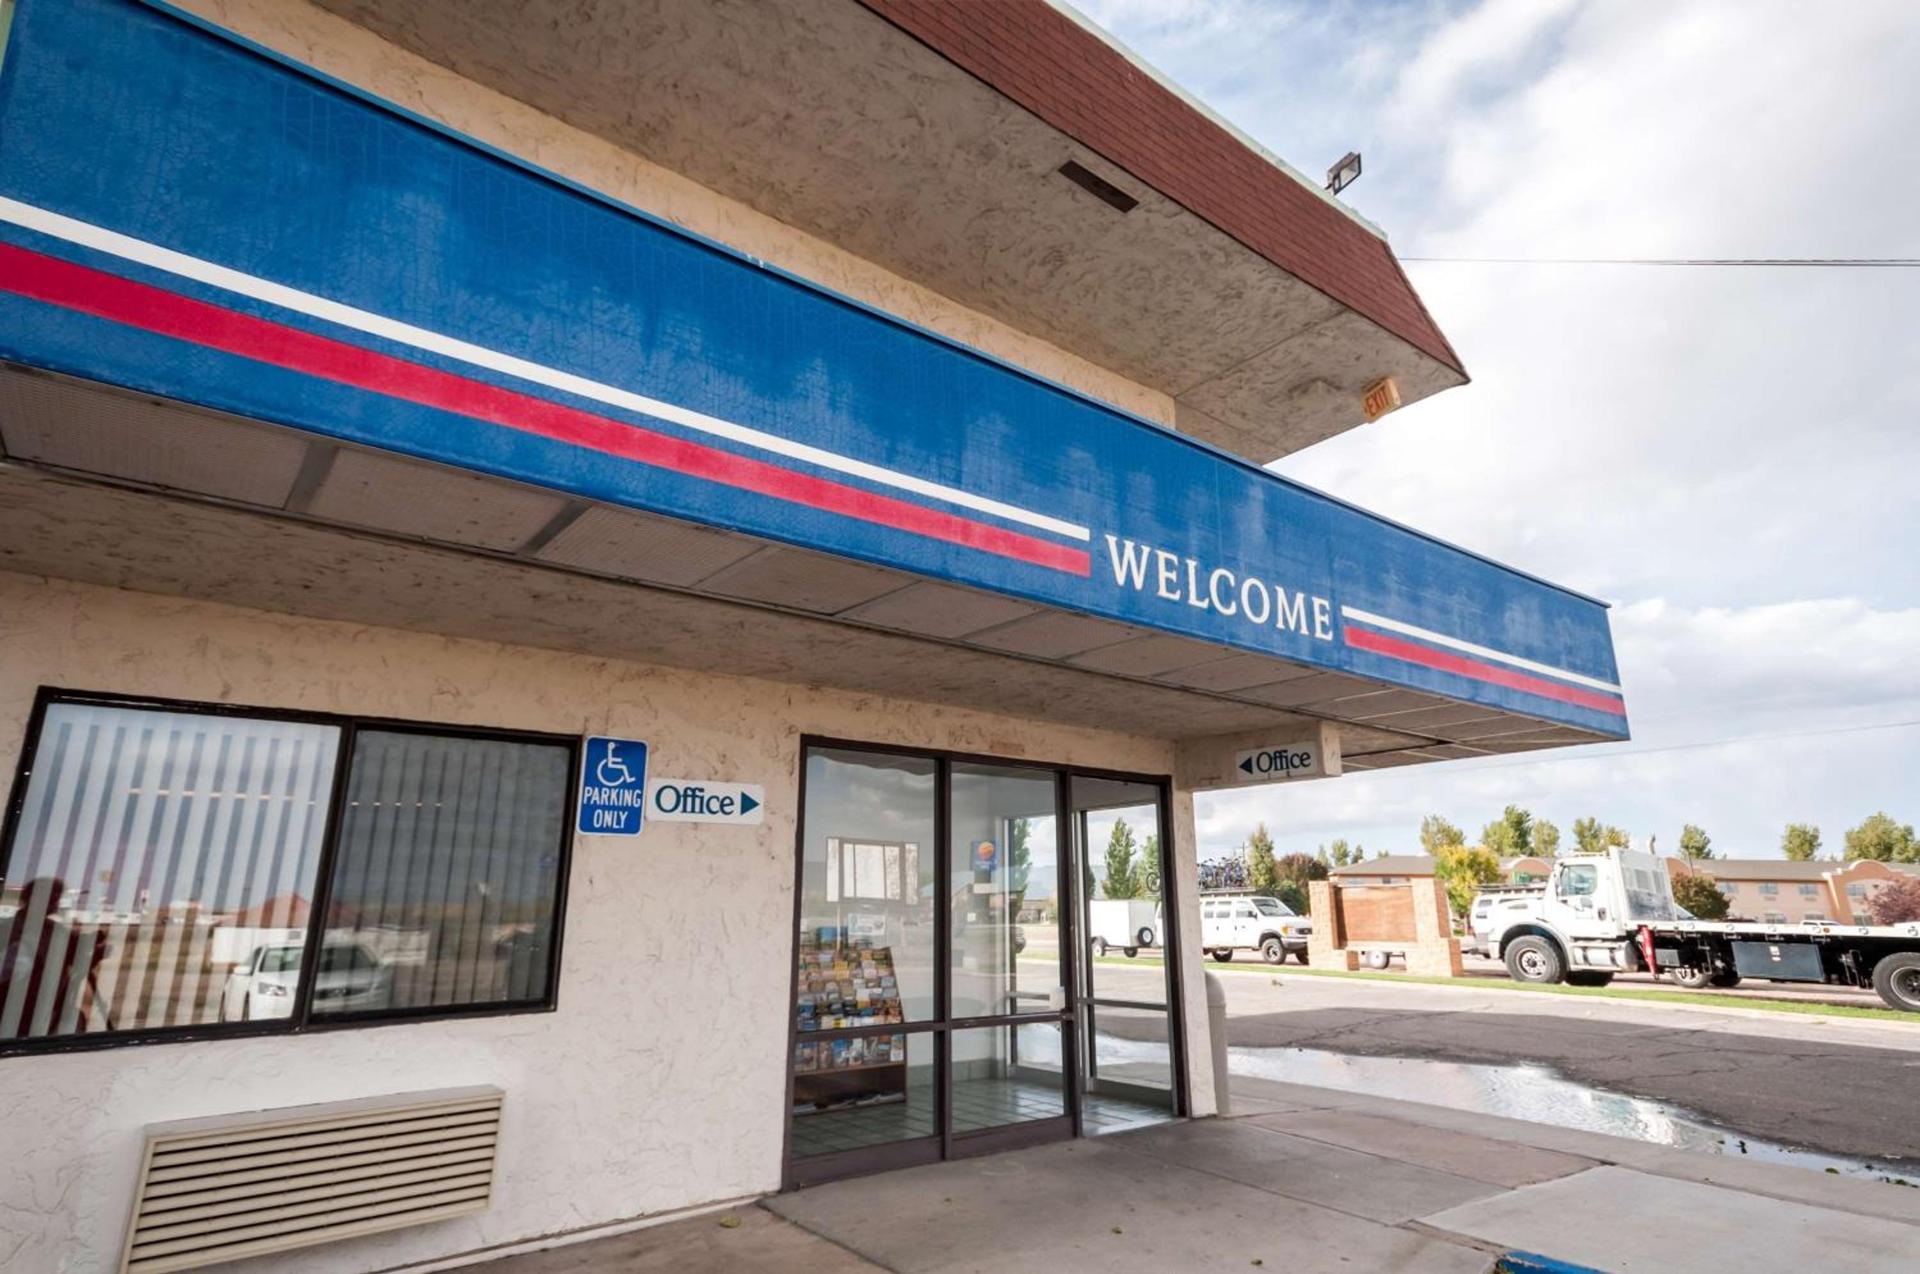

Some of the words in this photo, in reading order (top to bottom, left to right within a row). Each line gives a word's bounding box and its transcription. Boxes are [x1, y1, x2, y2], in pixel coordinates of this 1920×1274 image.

[1366, 384, 1390, 417] EXIT
[1105, 534, 1333, 641] WELCOME
[1256, 749, 1312, 773] Office
[583, 786, 642, 808] PARKING
[655, 785, 735, 816] Office
[593, 810, 628, 829] ONLY
